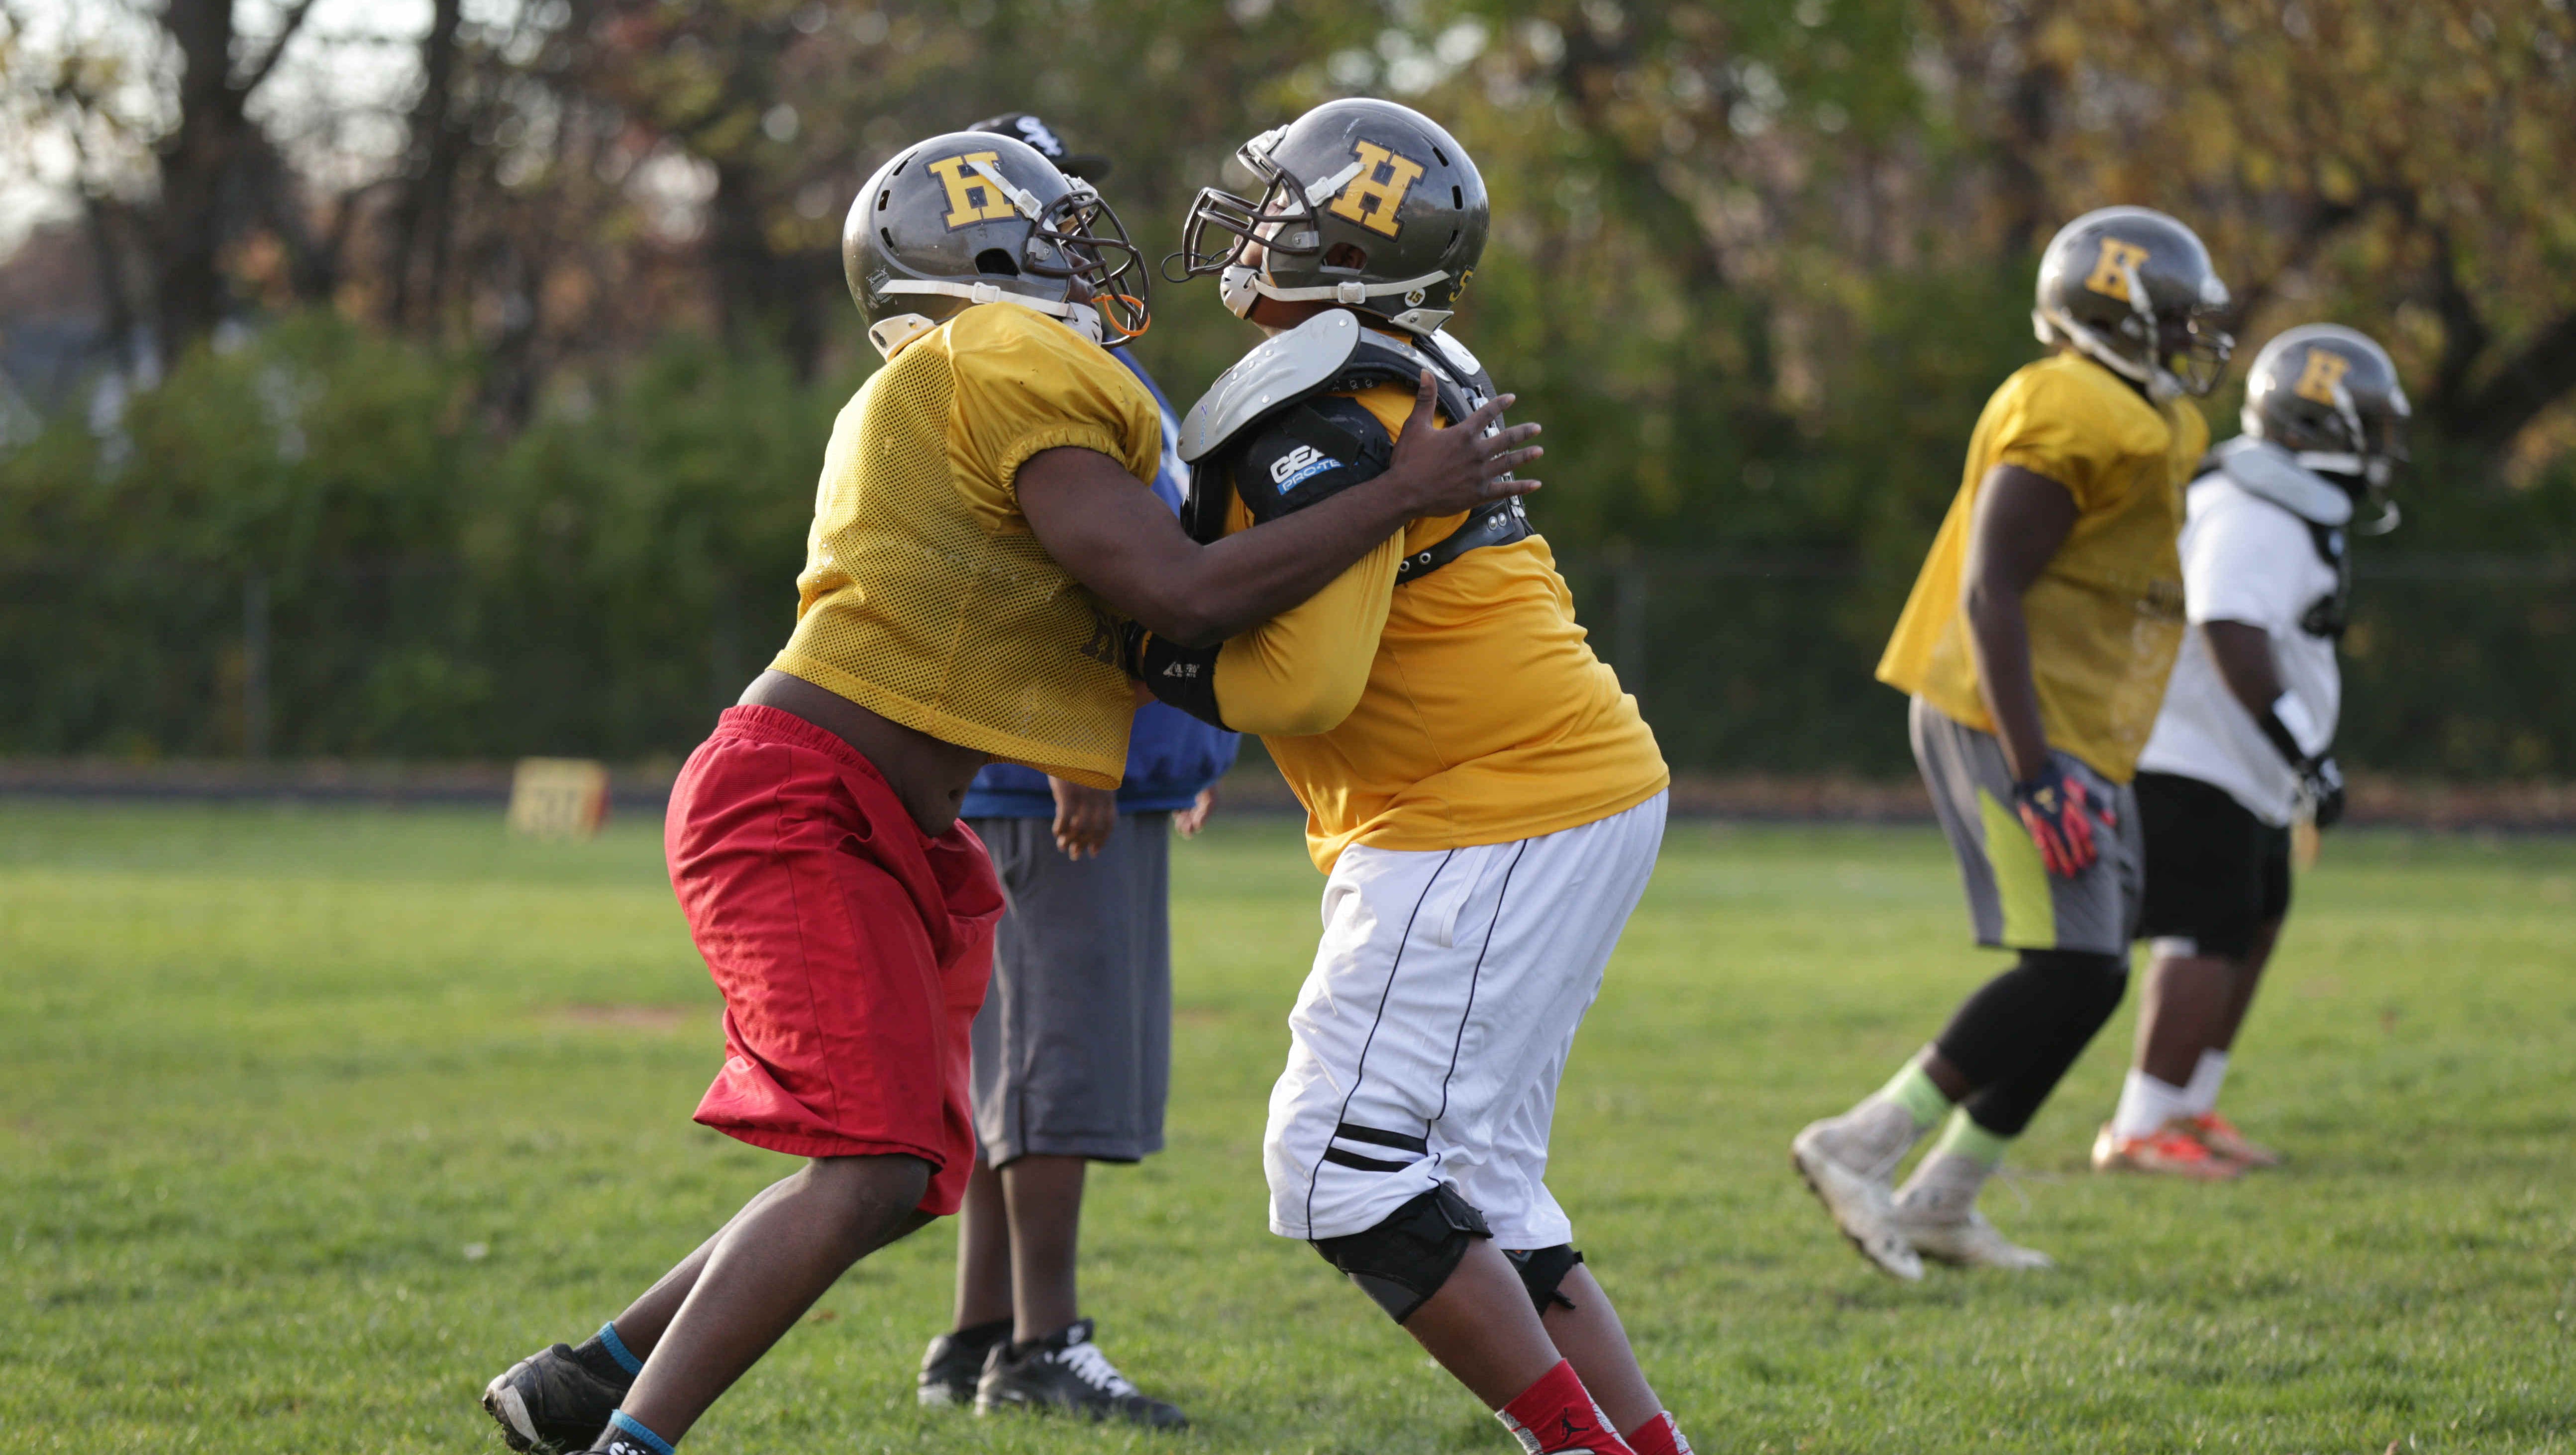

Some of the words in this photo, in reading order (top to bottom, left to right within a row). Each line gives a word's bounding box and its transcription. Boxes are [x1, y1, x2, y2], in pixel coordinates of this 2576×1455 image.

[926, 150, 1019, 231] H
[1327, 137, 1428, 242] H
[1407, 290, 1424, 303] 15
